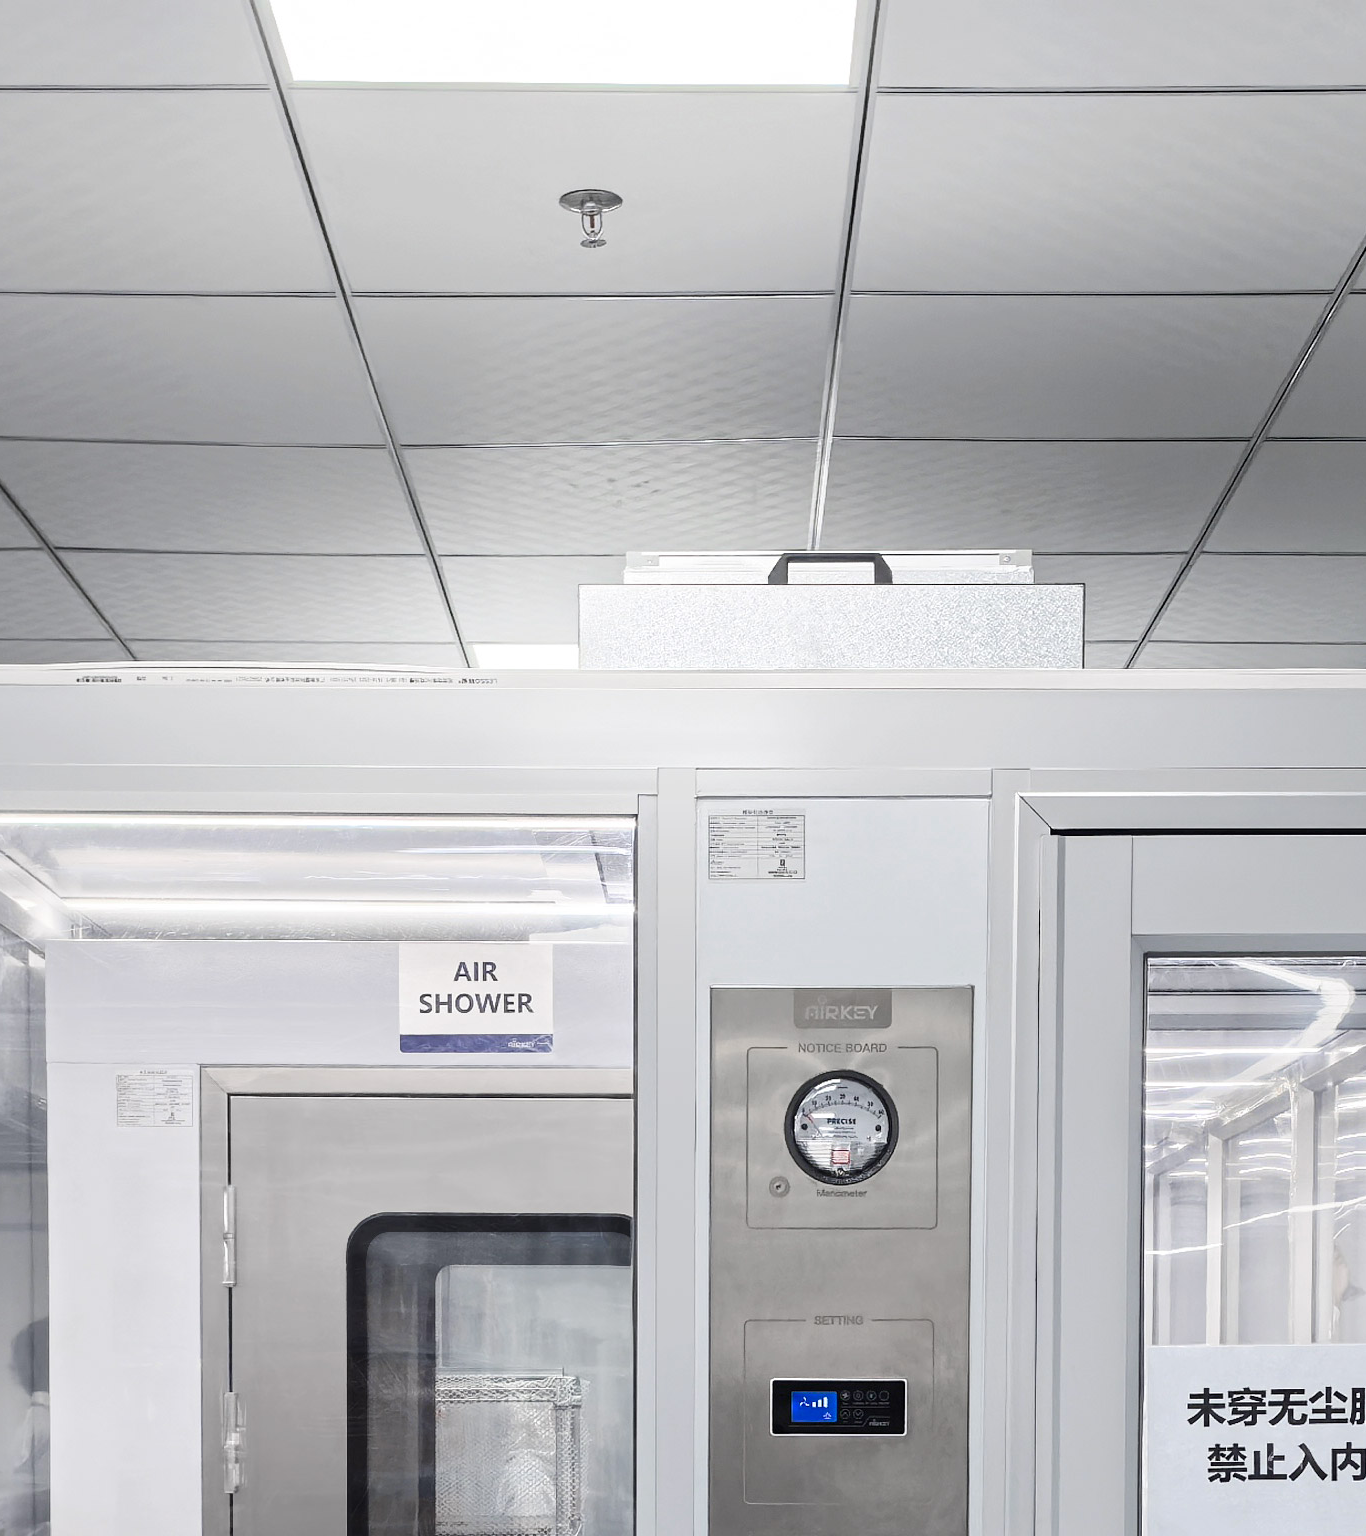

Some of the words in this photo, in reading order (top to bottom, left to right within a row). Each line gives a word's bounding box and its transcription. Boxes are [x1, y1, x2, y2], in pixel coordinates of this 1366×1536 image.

[454, 962, 498, 981] AIR
[420, 993, 534, 1014] SHOWER
[805, 995, 879, 1020] AIRKEY
[798, 1043, 842, 1053] NOTICE
[845, 1043, 888, 1053] BOARD
[814, 1315, 864, 1326] SETTING
[1207, 1441, 1366, 1483] 禁止入内
